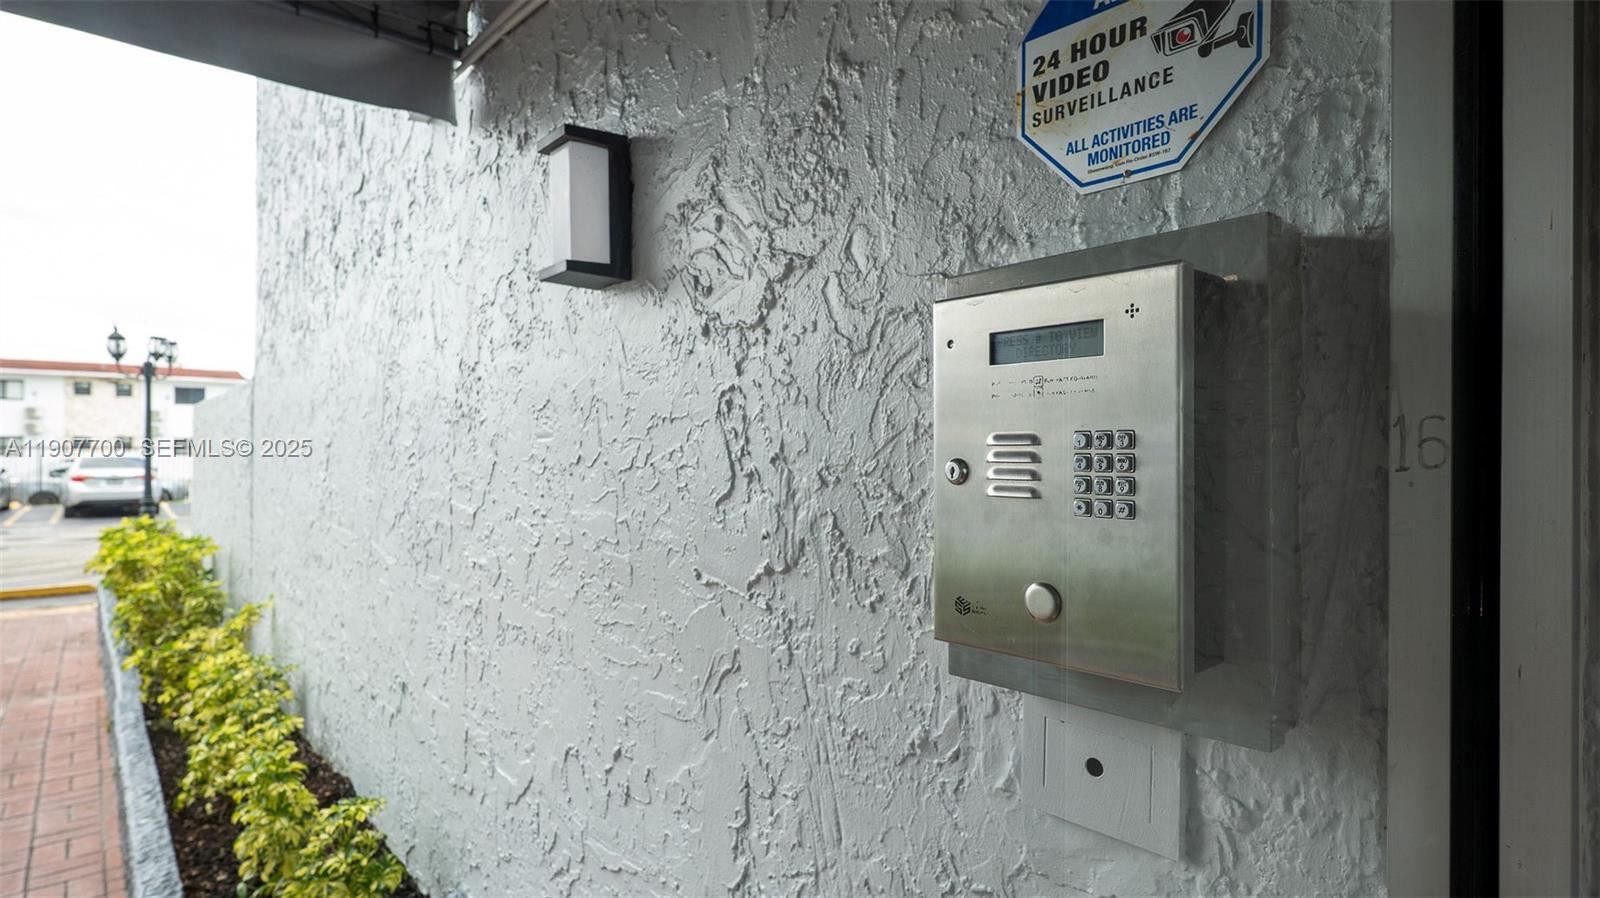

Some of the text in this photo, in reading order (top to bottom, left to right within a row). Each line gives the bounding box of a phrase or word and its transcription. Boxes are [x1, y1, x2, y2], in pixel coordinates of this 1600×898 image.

[1033, 16, 1148, 77] 24 HOUR
[1032, 60, 1110, 104] VIDEO
[1032, 66, 1174, 128] SURVEILLANCE
[1066, 103, 1198, 156] ALL ACTIVITIES ARE
[1087, 130, 1171, 167] MONITORED
[1392, 414, 1448, 473] 16
